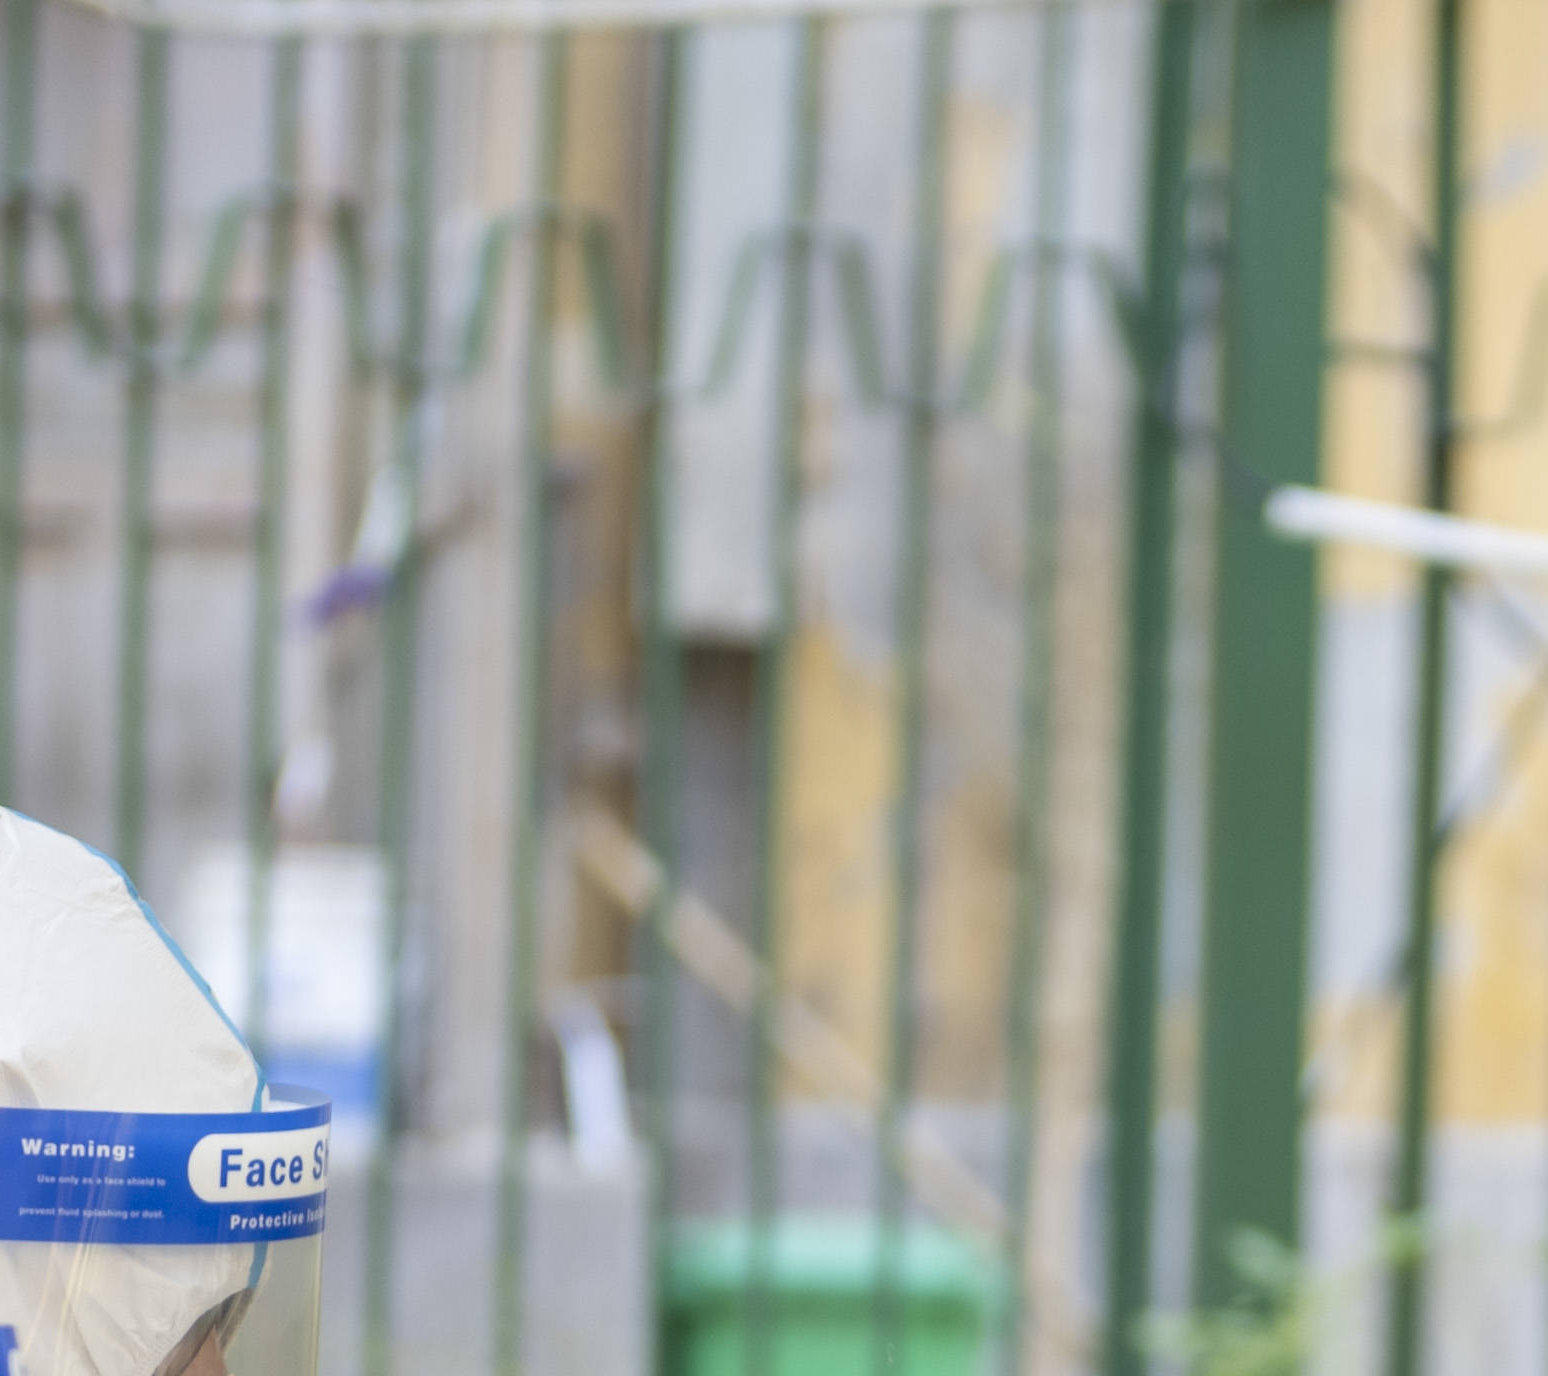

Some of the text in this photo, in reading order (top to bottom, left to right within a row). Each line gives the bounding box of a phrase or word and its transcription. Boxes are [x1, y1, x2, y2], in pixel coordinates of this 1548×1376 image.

[21, 1138, 135, 1161] Warning:
[220, 1148, 303, 1188] Face
[37, 1174, 55, 1183] Use
[58, 1175, 79, 1185] only
[104, 1176, 124, 1185] face
[127, 1176, 155, 1186] shield
[156, 1177, 166, 1186] to
[19, 1207, 55, 1217] prevent
[58, 1206, 79, 1216] fluid
[82, 1208, 128, 1219] splashing
[130, 1210, 140, 1218] or
[230, 1211, 303, 1230] Protective
